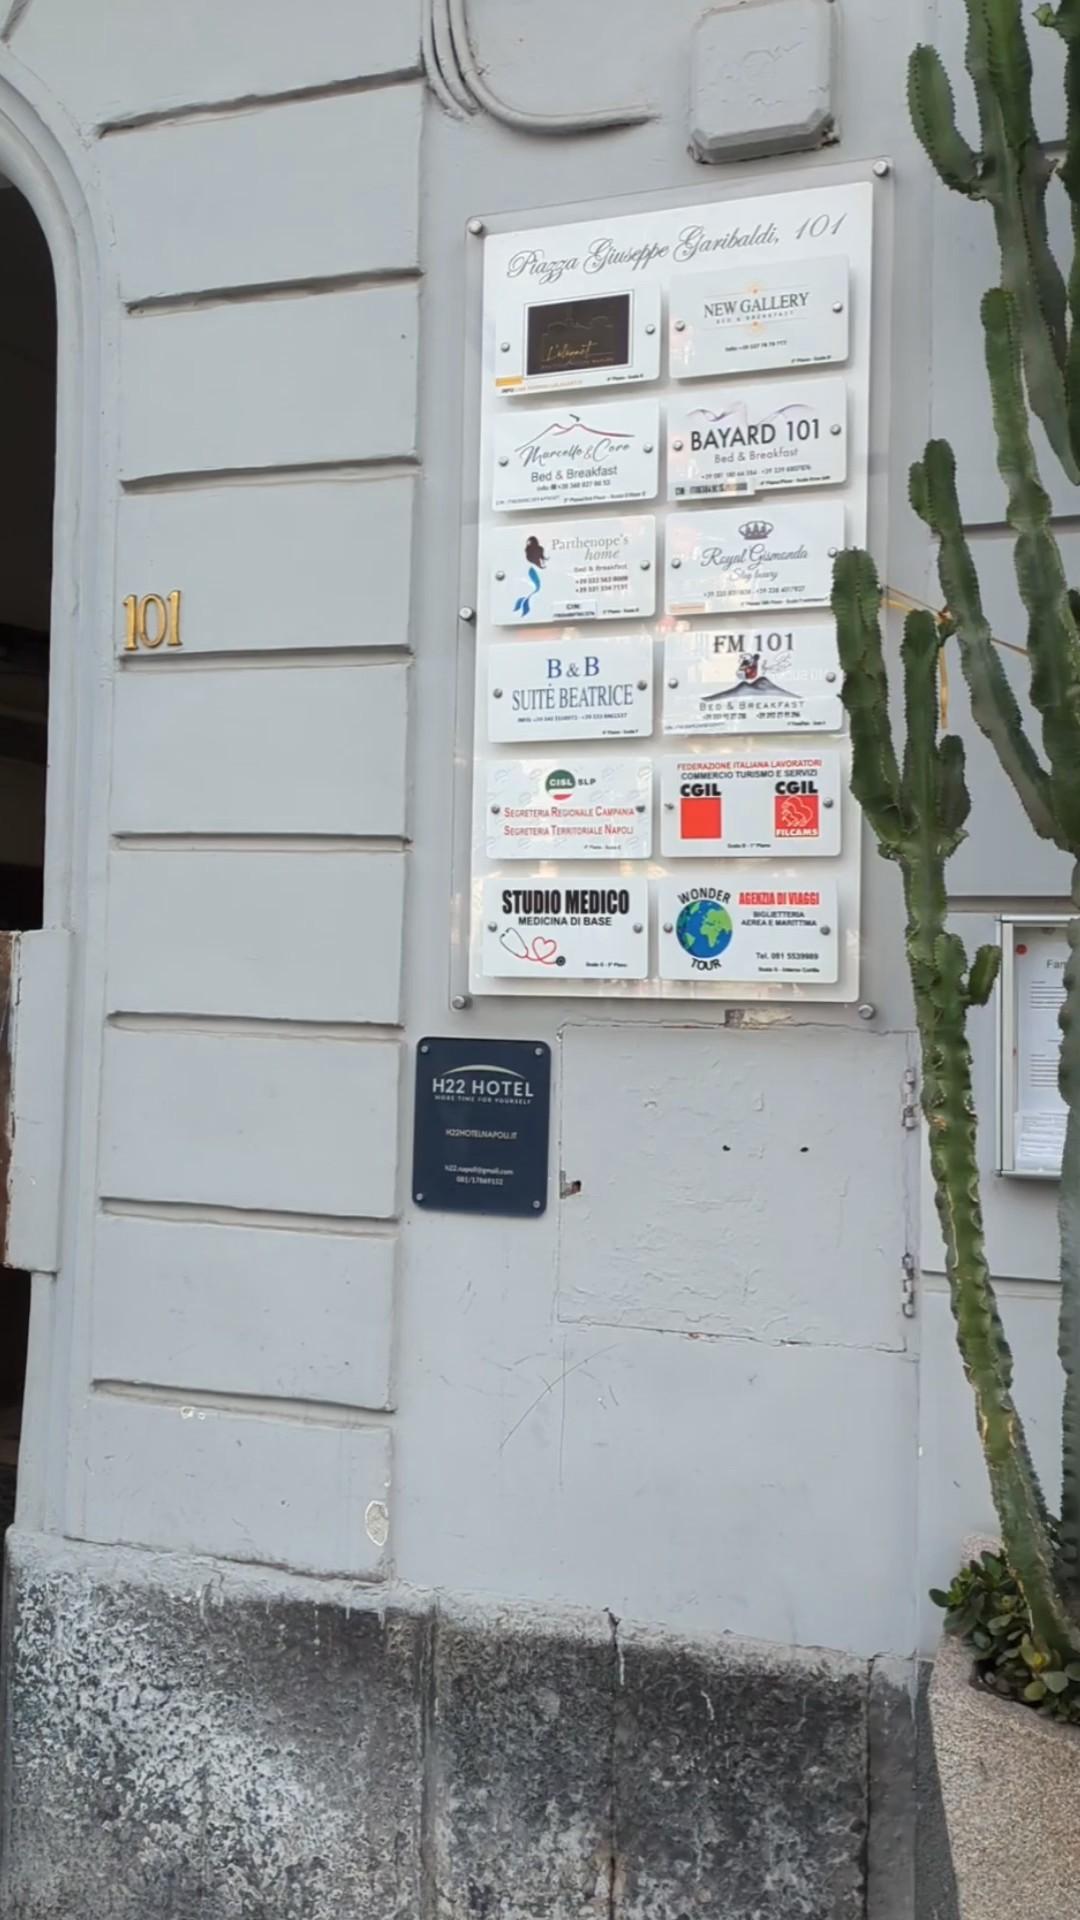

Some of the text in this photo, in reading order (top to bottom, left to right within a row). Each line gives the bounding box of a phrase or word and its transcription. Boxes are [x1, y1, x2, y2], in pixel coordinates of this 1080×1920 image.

[507, 213, 848, 286] Piazza Giuseppe Garibaldi, 101
[704, 291, 810, 318] NEW GALLERY
[690, 418, 820, 452] BAYARD 101
[714, 447, 799, 464] Bed & Breakfast
[531, 465, 618, 484] Bed & Breakfast
[552, 533, 629, 551] Parthenope's
[584, 548, 621, 562] home
[701, 543, 809, 571] Royal Gismonda
[122, 590, 183, 652] 101
[714, 632, 794, 654] FM 101
[547, 655, 600, 680] B & B
[559, 684, 634, 709] BEATRICE
[700, 700, 805, 712] BED & BREAKFAST
[677, 759, 823, 771] FEDERAZIONE ITALIANA LAVORATORI
[549, 777, 574, 787] CISL
[681, 769, 818, 781] COMMERCIO TURISMO E SERVIZI
[577, 778, 597, 787] SLP
[775, 780, 819, 795] CGIL
[680, 783, 722, 797] CGIL
[503, 805, 636, 818] SEGRETERIA REGIONALE CAMPANIA
[503, 824, 634, 837] SEGRETERIA TERRITORIALE NAPOLI
[775, 828, 818, 837] FILCAMS
[502, 888, 630, 915] STUDIO MEDICO
[677, 887, 731, 905] WONDER
[739, 892, 820, 906] AGENZIA DI VIAGGI
[518, 916, 613, 926] MEDICINA DI BASE
[752, 911, 806, 919] BIGLIETTERIA
[741, 919, 817, 927] AEREA E MARITTIMA
[756, 952, 769, 960] Tel.
[771, 952, 785, 960] 081
[690, 958, 722, 972] TOUR
[432, 1078, 535, 1098] H22 HOTEL
[495, 1097, 531, 1105] YOURSELF
